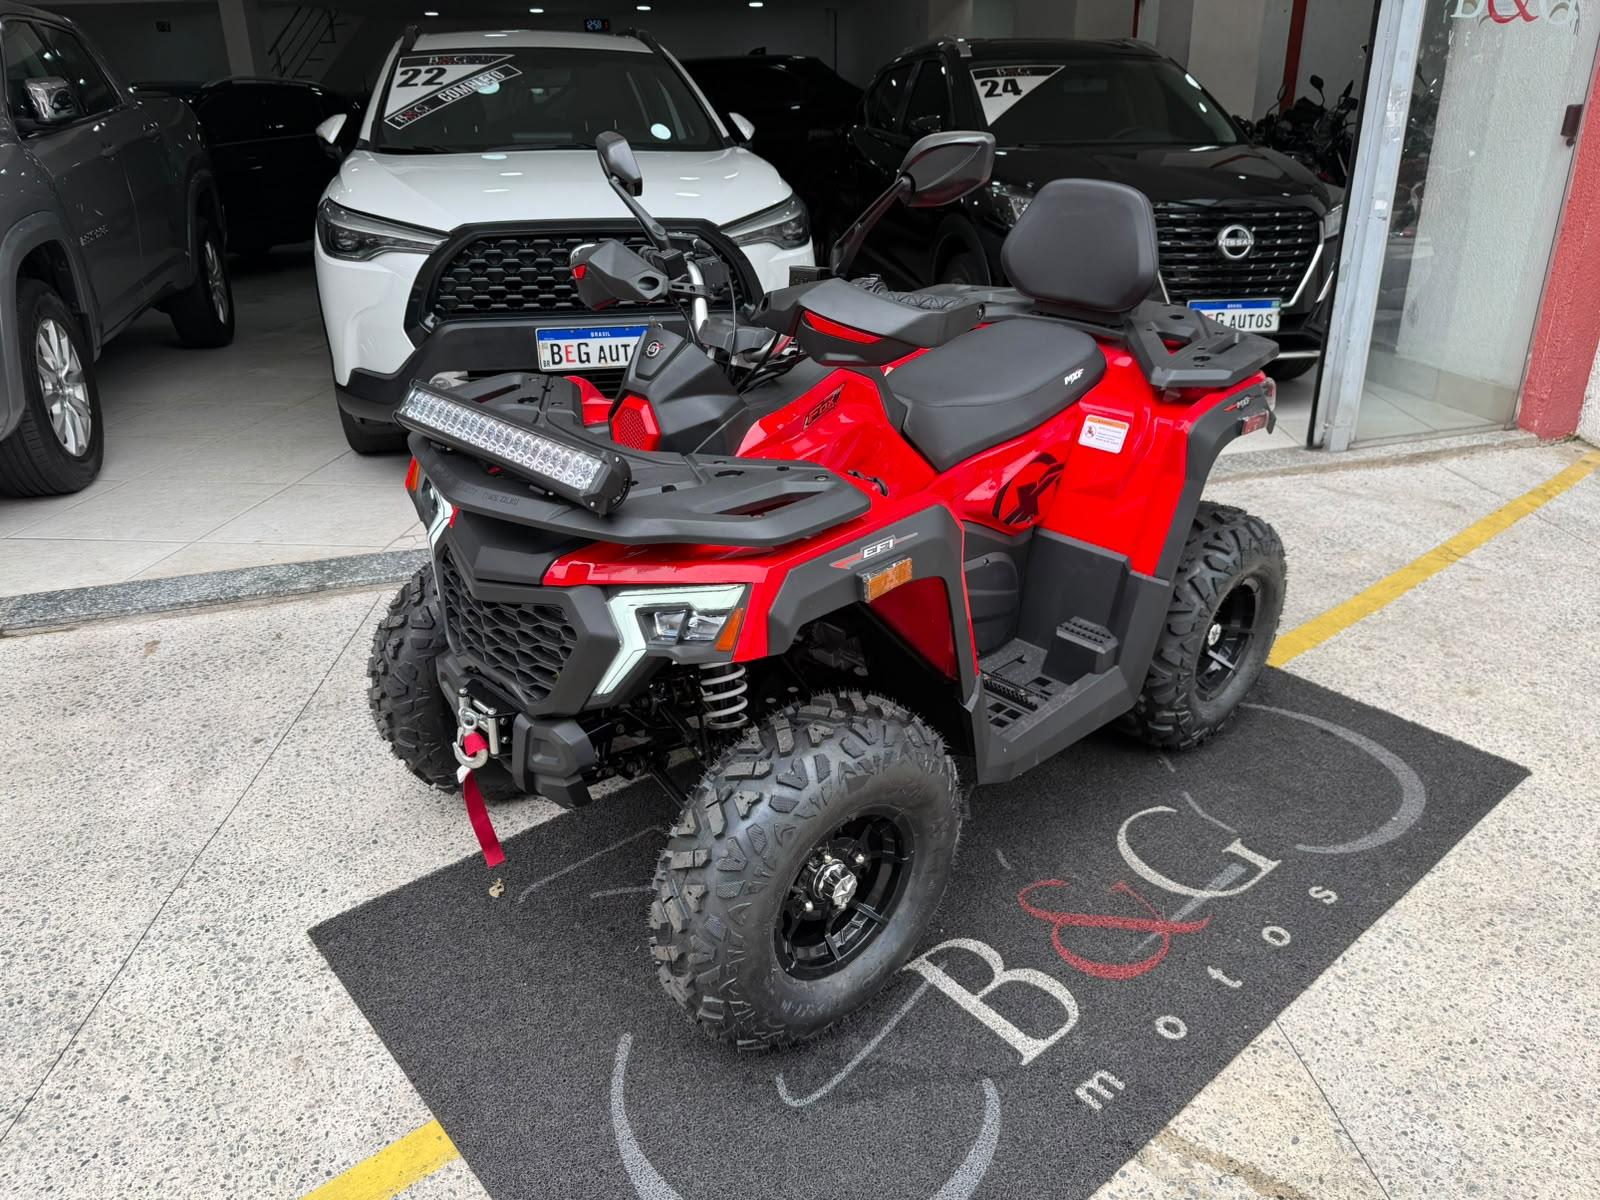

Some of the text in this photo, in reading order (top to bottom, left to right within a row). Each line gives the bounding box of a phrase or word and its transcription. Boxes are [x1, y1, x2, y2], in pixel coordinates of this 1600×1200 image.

[396, 67, 447, 88] 22
[437, 70, 506, 102] COMPLETO
[980, 79, 1023, 98] 24
[1218, 238, 1254, 247] NISSAN
[1230, 313, 1273, 329] AUTOS
[550, 342, 590, 365] BEG
[598, 343, 634, 364] AUT
[1064, 368, 1084, 385] MXF
[863, 538, 894, 558] EFI
